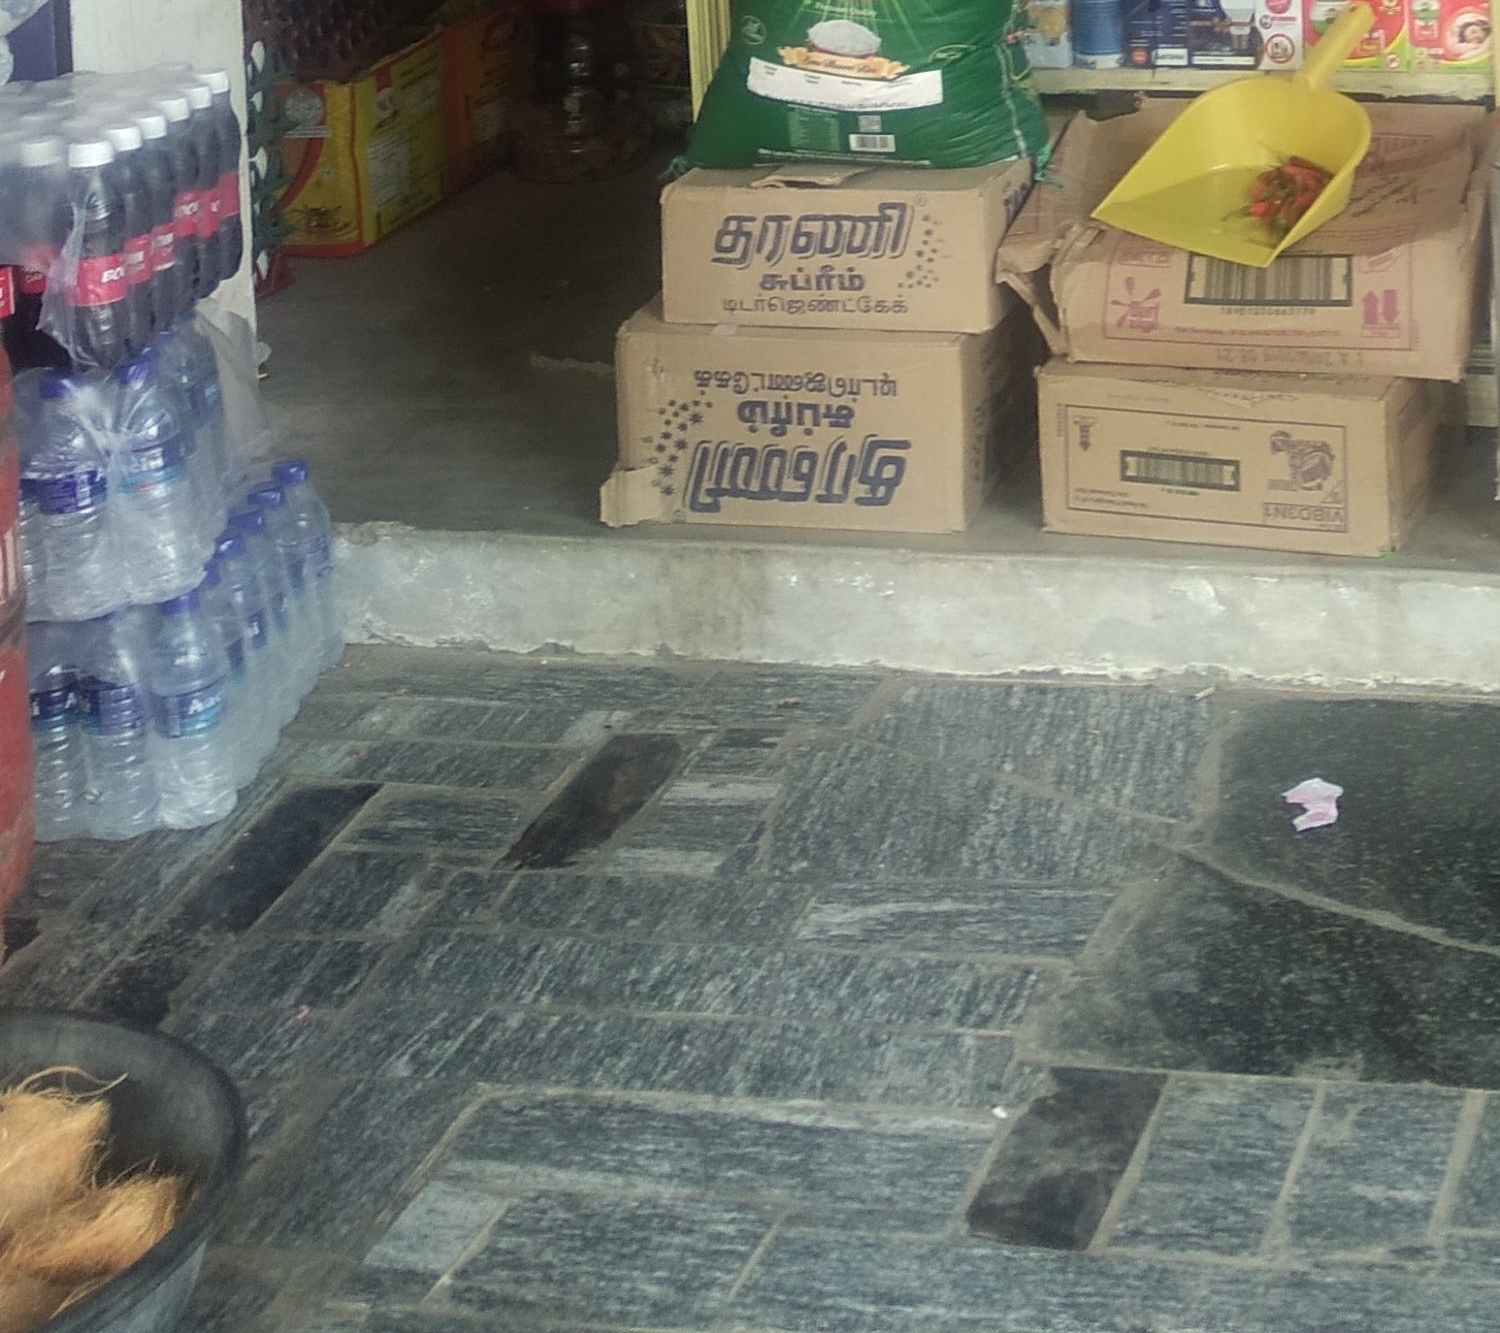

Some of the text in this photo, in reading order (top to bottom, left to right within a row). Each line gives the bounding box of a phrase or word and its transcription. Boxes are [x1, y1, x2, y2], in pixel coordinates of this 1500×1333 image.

[711, 202, 914, 269] தரணி
[759, 264, 866, 291] சுப்ரீம்
[736, 397, 857, 437] சுப்ரீம்
[684, 434, 912, 513] தரணி
